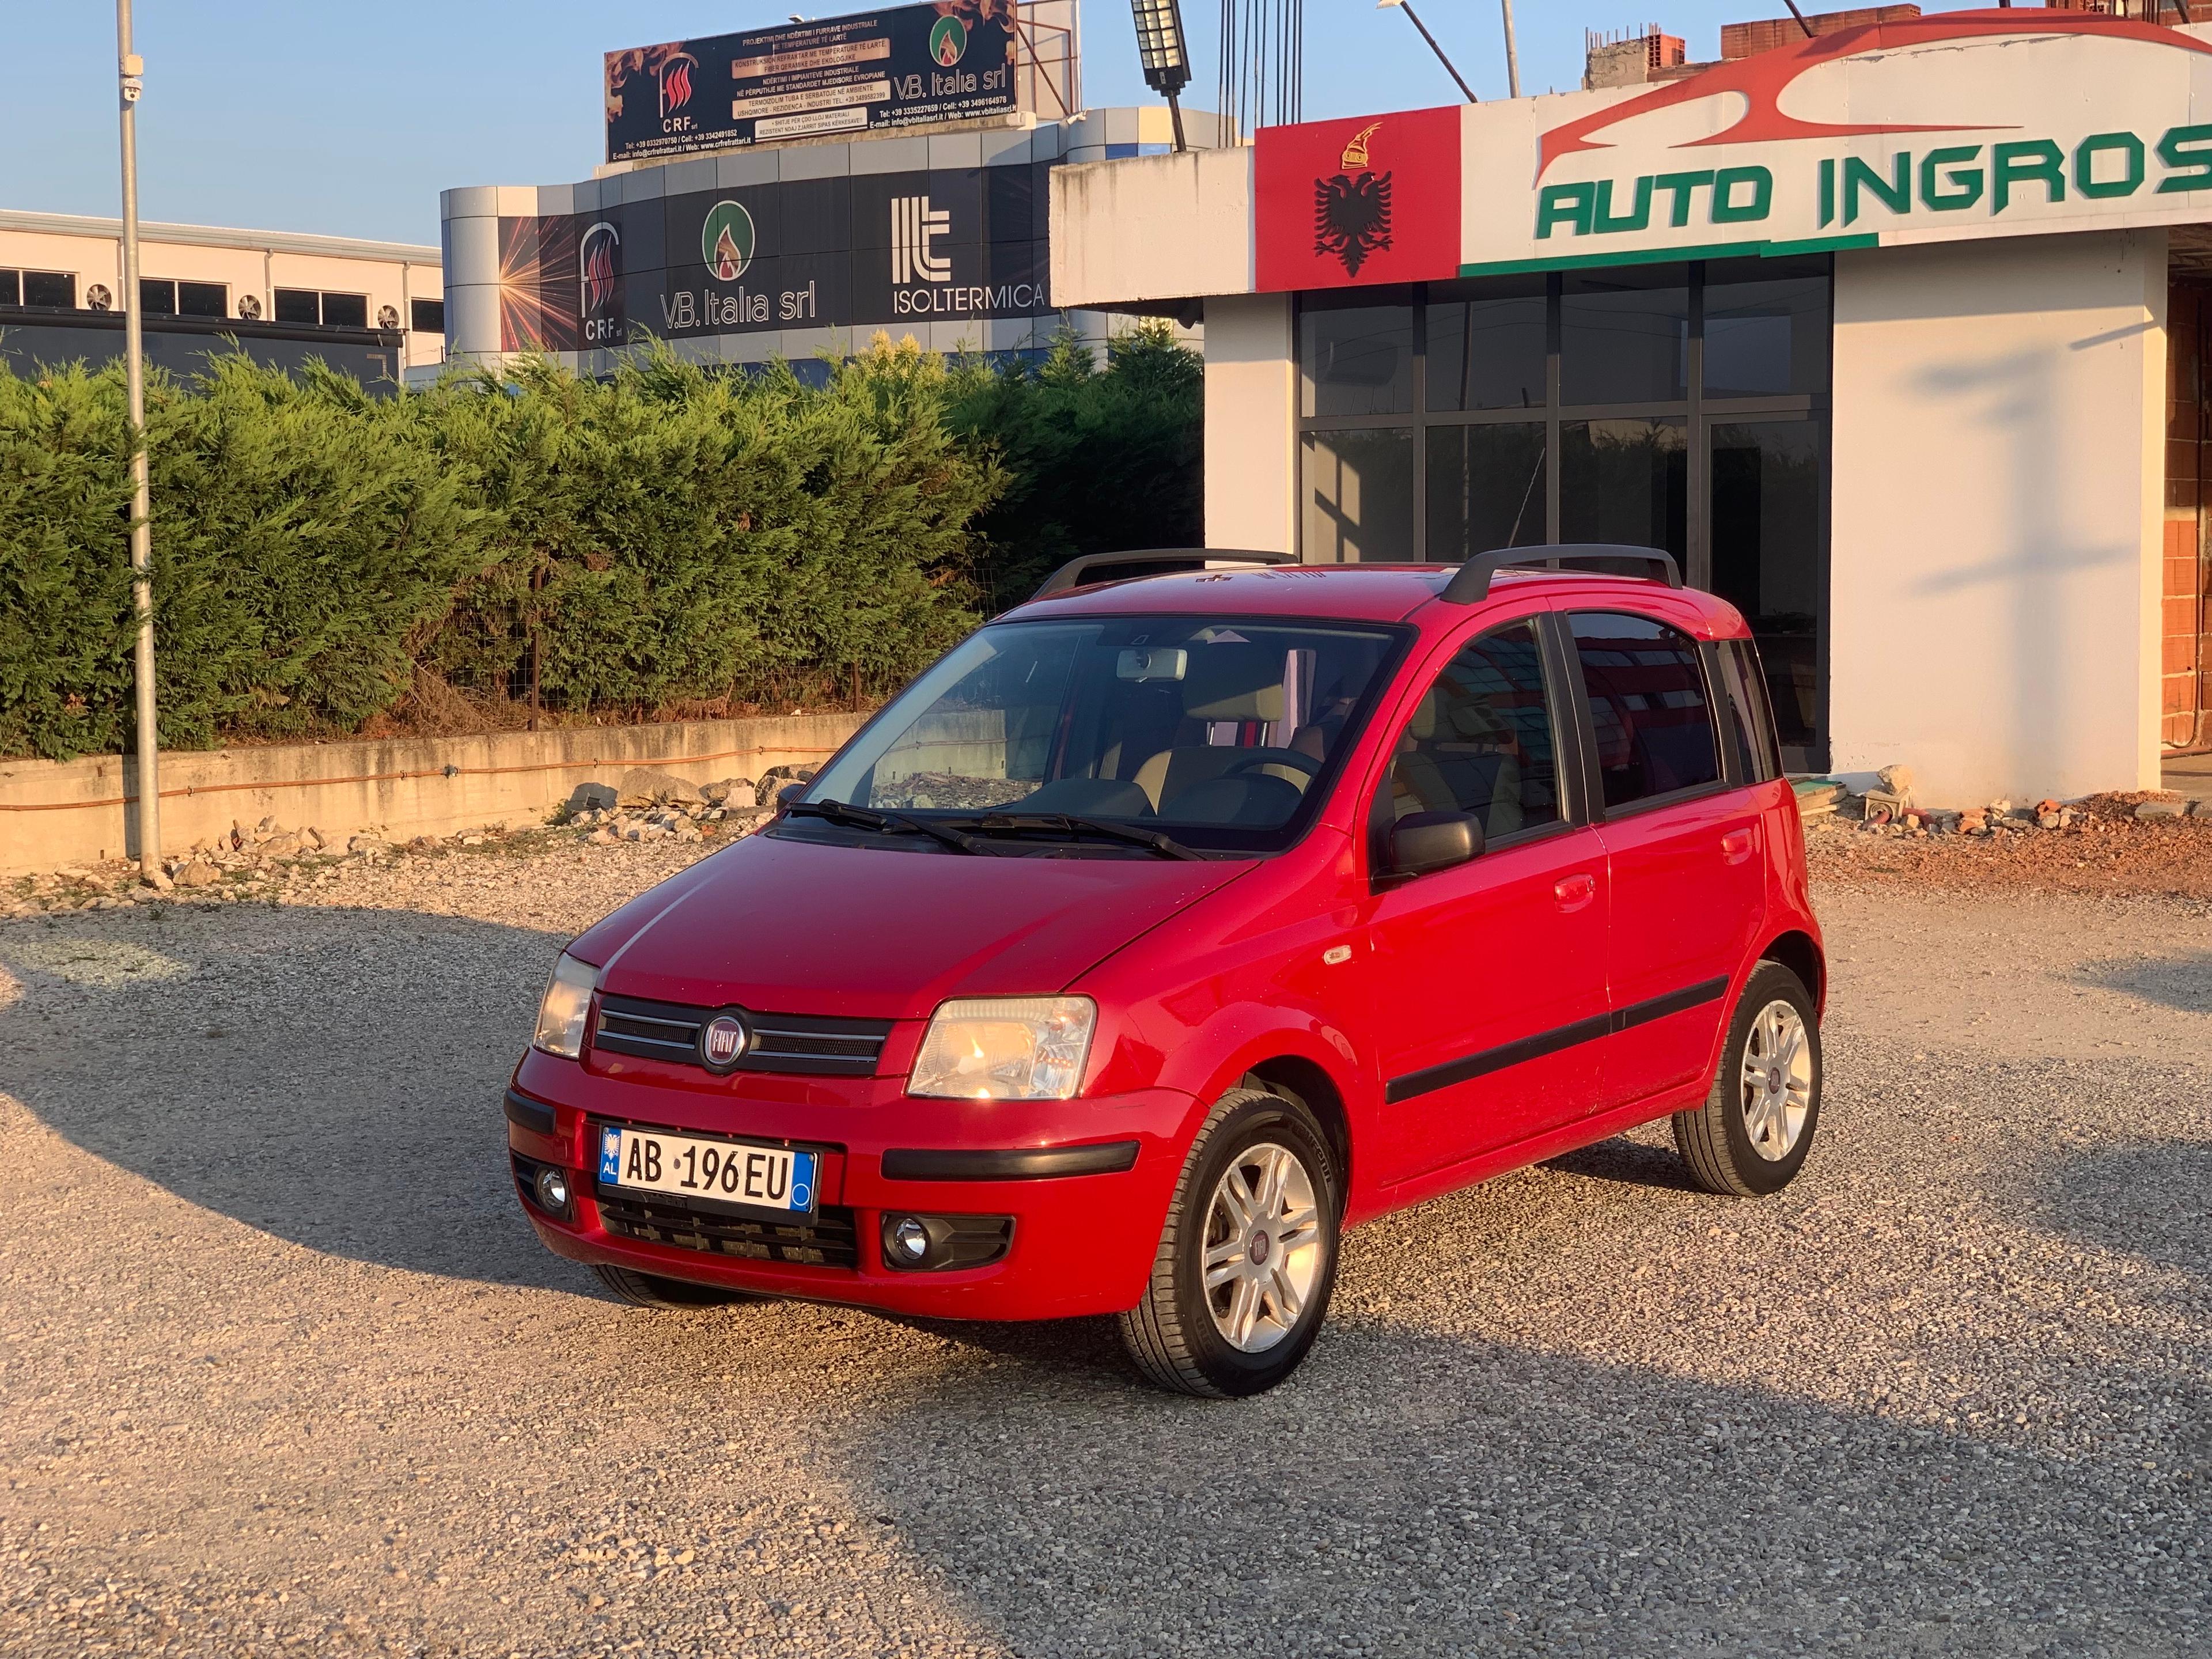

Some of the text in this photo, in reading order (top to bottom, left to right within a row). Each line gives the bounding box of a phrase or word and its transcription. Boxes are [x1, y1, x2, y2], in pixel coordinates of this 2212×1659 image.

[742, 35, 774, 46] PROJEKTIMI
[787, 29, 812, 39] NDËRTIMI
[816, 25, 841, 35] FURRAVE
[842, 20, 878, 31] INDUSTRIALE
[735, 56, 776, 68] KONSTRUKSION
[777, 52, 808, 62] REFRAKTAR
[764, 64, 779, 73] FIBER
[809, 58, 820, 66] DHE
[821, 54, 856, 65] EKOLOGJIKE
[745, 86, 776, 96] PËRPUTHJE
[786, 79, 821, 91] STANDARDET
[822, 75, 853, 86] MJEDISORE
[854, 71, 885, 82] EVROPIANE
[763, 75, 788, 85] NDËRTIMI
[791, 70, 823, 81] IMPIANTEVE
[824, 66, 859, 77] INDUSTRIALE
[931, 69, 977, 97] Italia
[983, 63, 1006, 90] srl
[748, 97, 783, 107] TERMOIZOLIM
[785, 94, 799, 103] TUBA
[805, 89, 836, 100] SERBATOJE
[846, 85, 873, 94] AMBIENTE
[880, 109, 891, 118] Tel:
[891, 108, 902, 116] +39
[903, 104, 938, 116] 3335227659
[942, 102, 957, 111] Cell:
[958, 100, 969, 108] +39
[971, 96, 1007, 107] 3496164978
[737, 107, 768, 117] USHQIMORE
[807, 99, 831, 108] INDUSTRI
[825, 111, 850, 120] MATERIALI
[663, 116, 691, 133] CRF
[759, 127, 783, 135] REZISTENT
[798, 123, 817, 131] ZJARRIT
[870, 120, 891, 129] E-mail:
[891, 113, 944, 127] info@vbitaliasrl.it
[948, 111, 963, 120] Web:
[681, 135, 694, 143] Cell:
[695, 133, 704, 141] +39
[706, 129, 737, 140] 3342491852
[613, 151, 631, 160] E-mail:
[685, 143, 699, 151] Web:
[700, 137, 751, 150] www.crfrefrattari.it
[1535, 123, 2212, 240] AUTO INGROS
[704, 286, 769, 325] Italia
[779, 281, 815, 320] srl
[893, 283, 1045, 315] ISOLTERMICA
[585, 317, 614, 341] CRF
[712, 1030, 737, 1053] FIAT
[603, 1162, 617, 1176] AL
[627, 1138, 789, 1200] AB 196EU
[1255, 1238, 1267, 1256] FIAT
